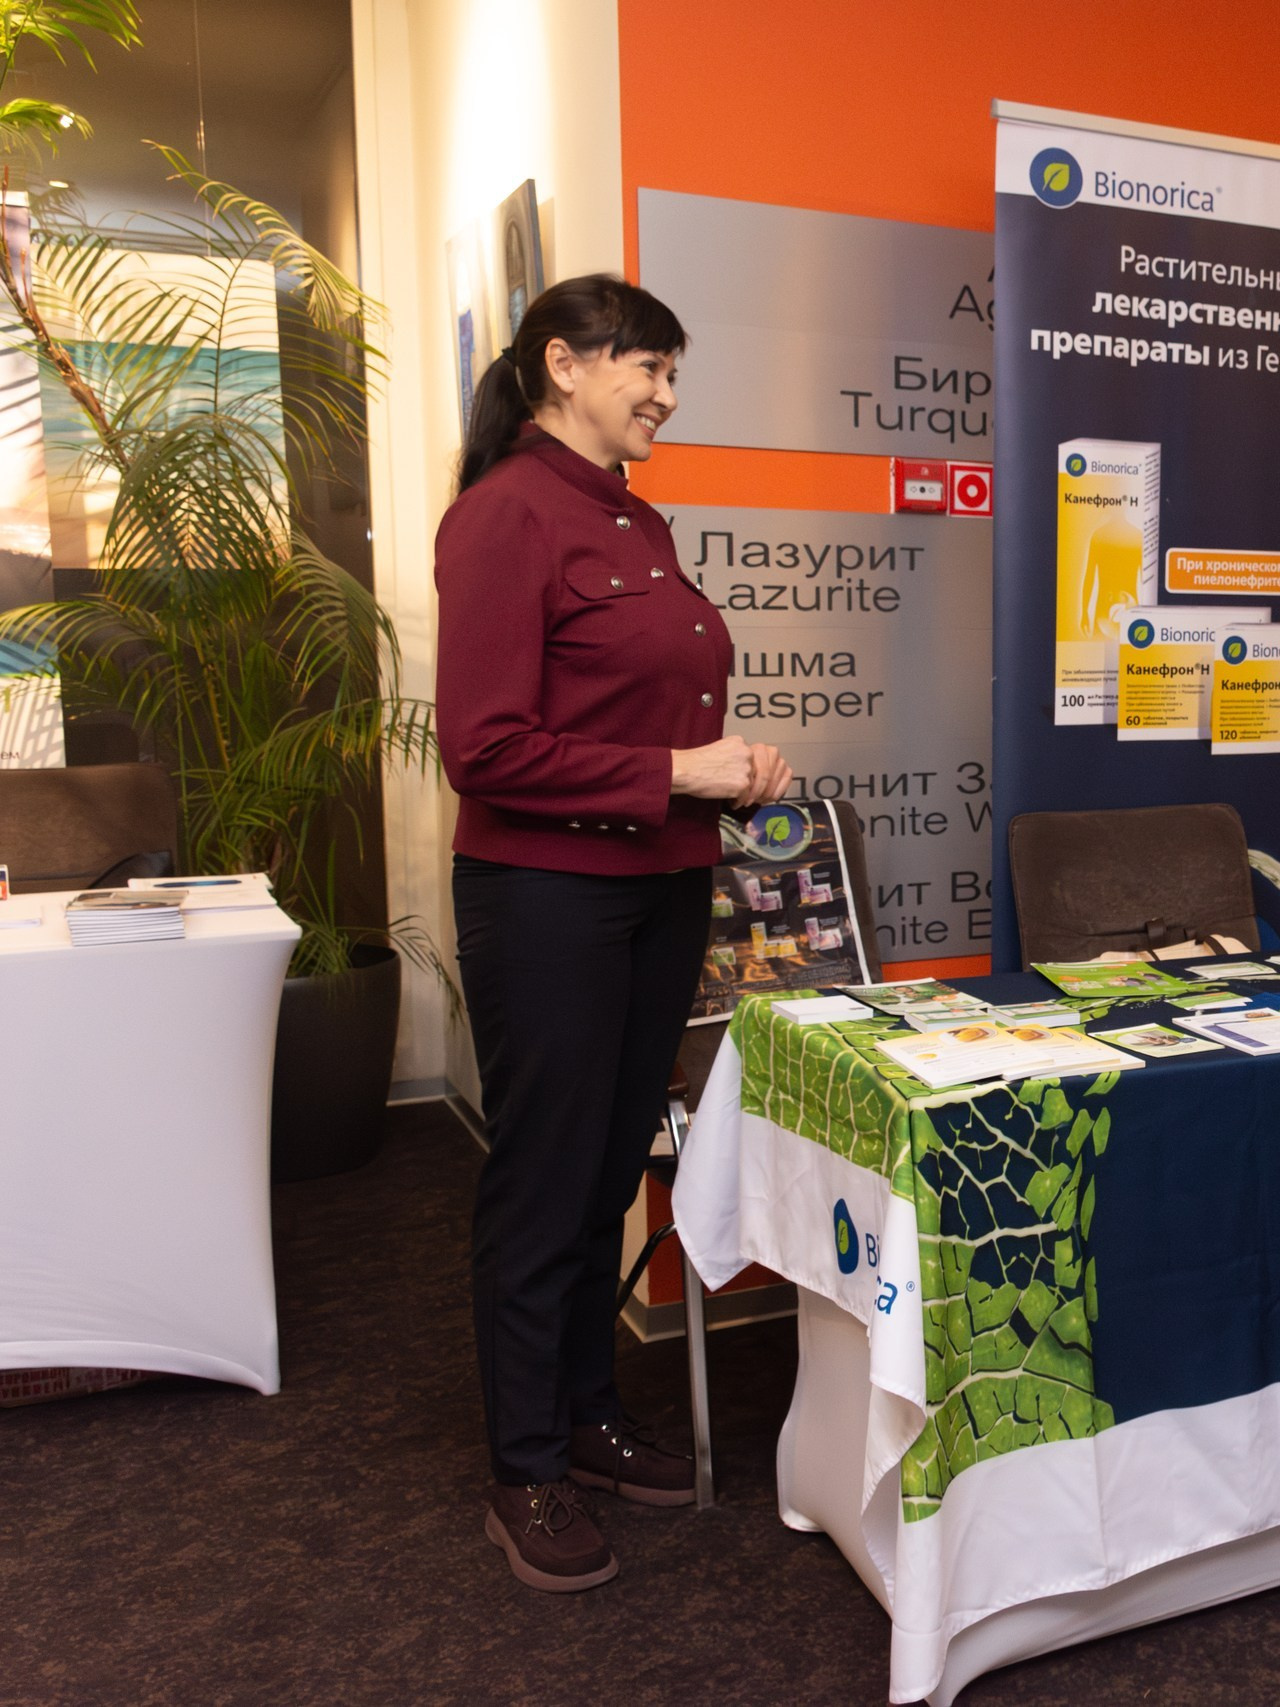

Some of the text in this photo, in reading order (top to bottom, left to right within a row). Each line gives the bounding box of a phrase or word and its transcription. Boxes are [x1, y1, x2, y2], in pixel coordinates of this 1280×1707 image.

[1030, 329, 1210, 367] препараты
[1218, 348, 1248, 371] из
[840, 390, 993, 444] Turqu
[694, 531, 924, 578] Лазурит
[1177, 557, 1203, 573] При
[731, 643, 856, 680] шма
[733, 690, 883, 727] asper
[1061, 695, 1085, 707] 100
[1126, 715, 1140, 726] 60
[1219, 730, 1237, 740] 120
